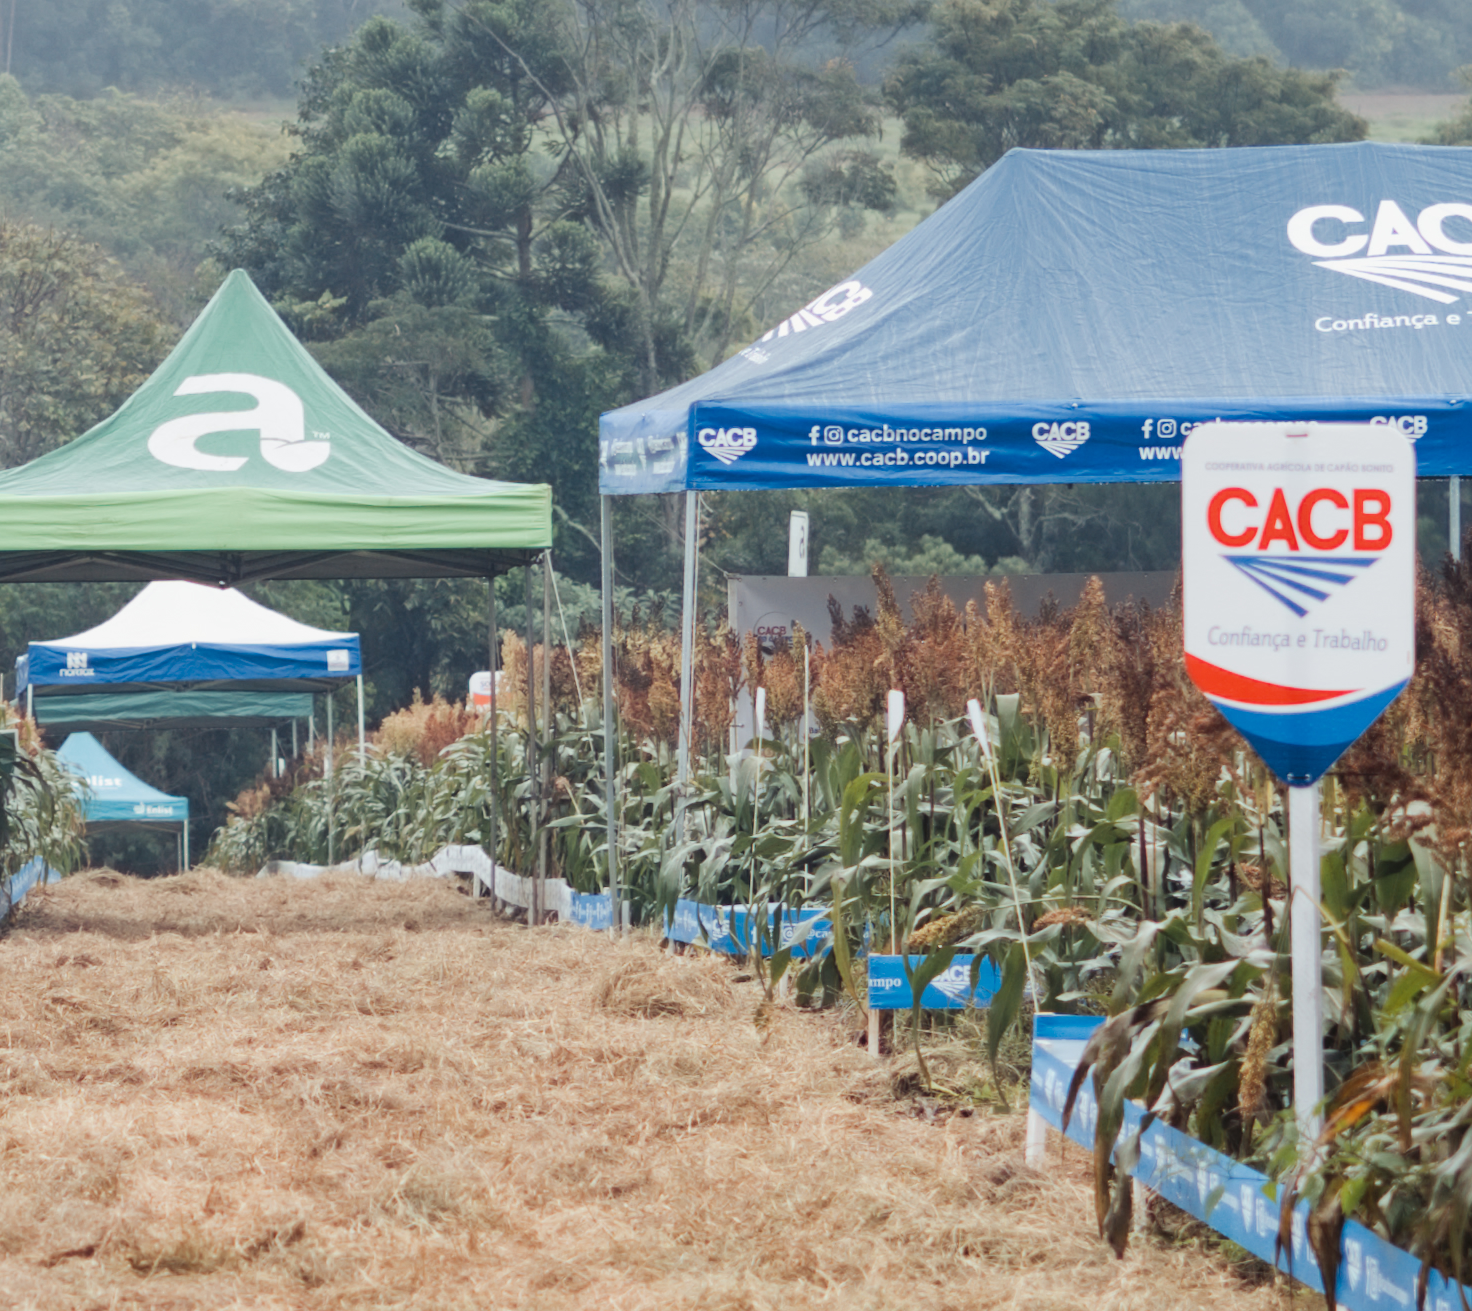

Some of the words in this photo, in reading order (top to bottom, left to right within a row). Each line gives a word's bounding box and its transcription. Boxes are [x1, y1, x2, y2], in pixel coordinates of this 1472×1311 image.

[1315, 313, 1438, 332] Confiança
[1447, 315, 1460, 325] e
[699, 428, 757, 447] CACB
[847, 425, 987, 444] cacbnocampo
[1032, 422, 1090, 441] CACB
[807, 447, 990, 468] www.cacb.coop.br
[1205, 462, 1264, 471] COOPERATIVA
[1361, 464, 1393, 473] BONITO
[1208, 487, 1393, 551] CACB
[757, 626, 786, 636] CACB
[1208, 626, 1291, 651] Confiança
[1296, 633, 1306, 648] e
[1313, 629, 1388, 651] Trabalho
